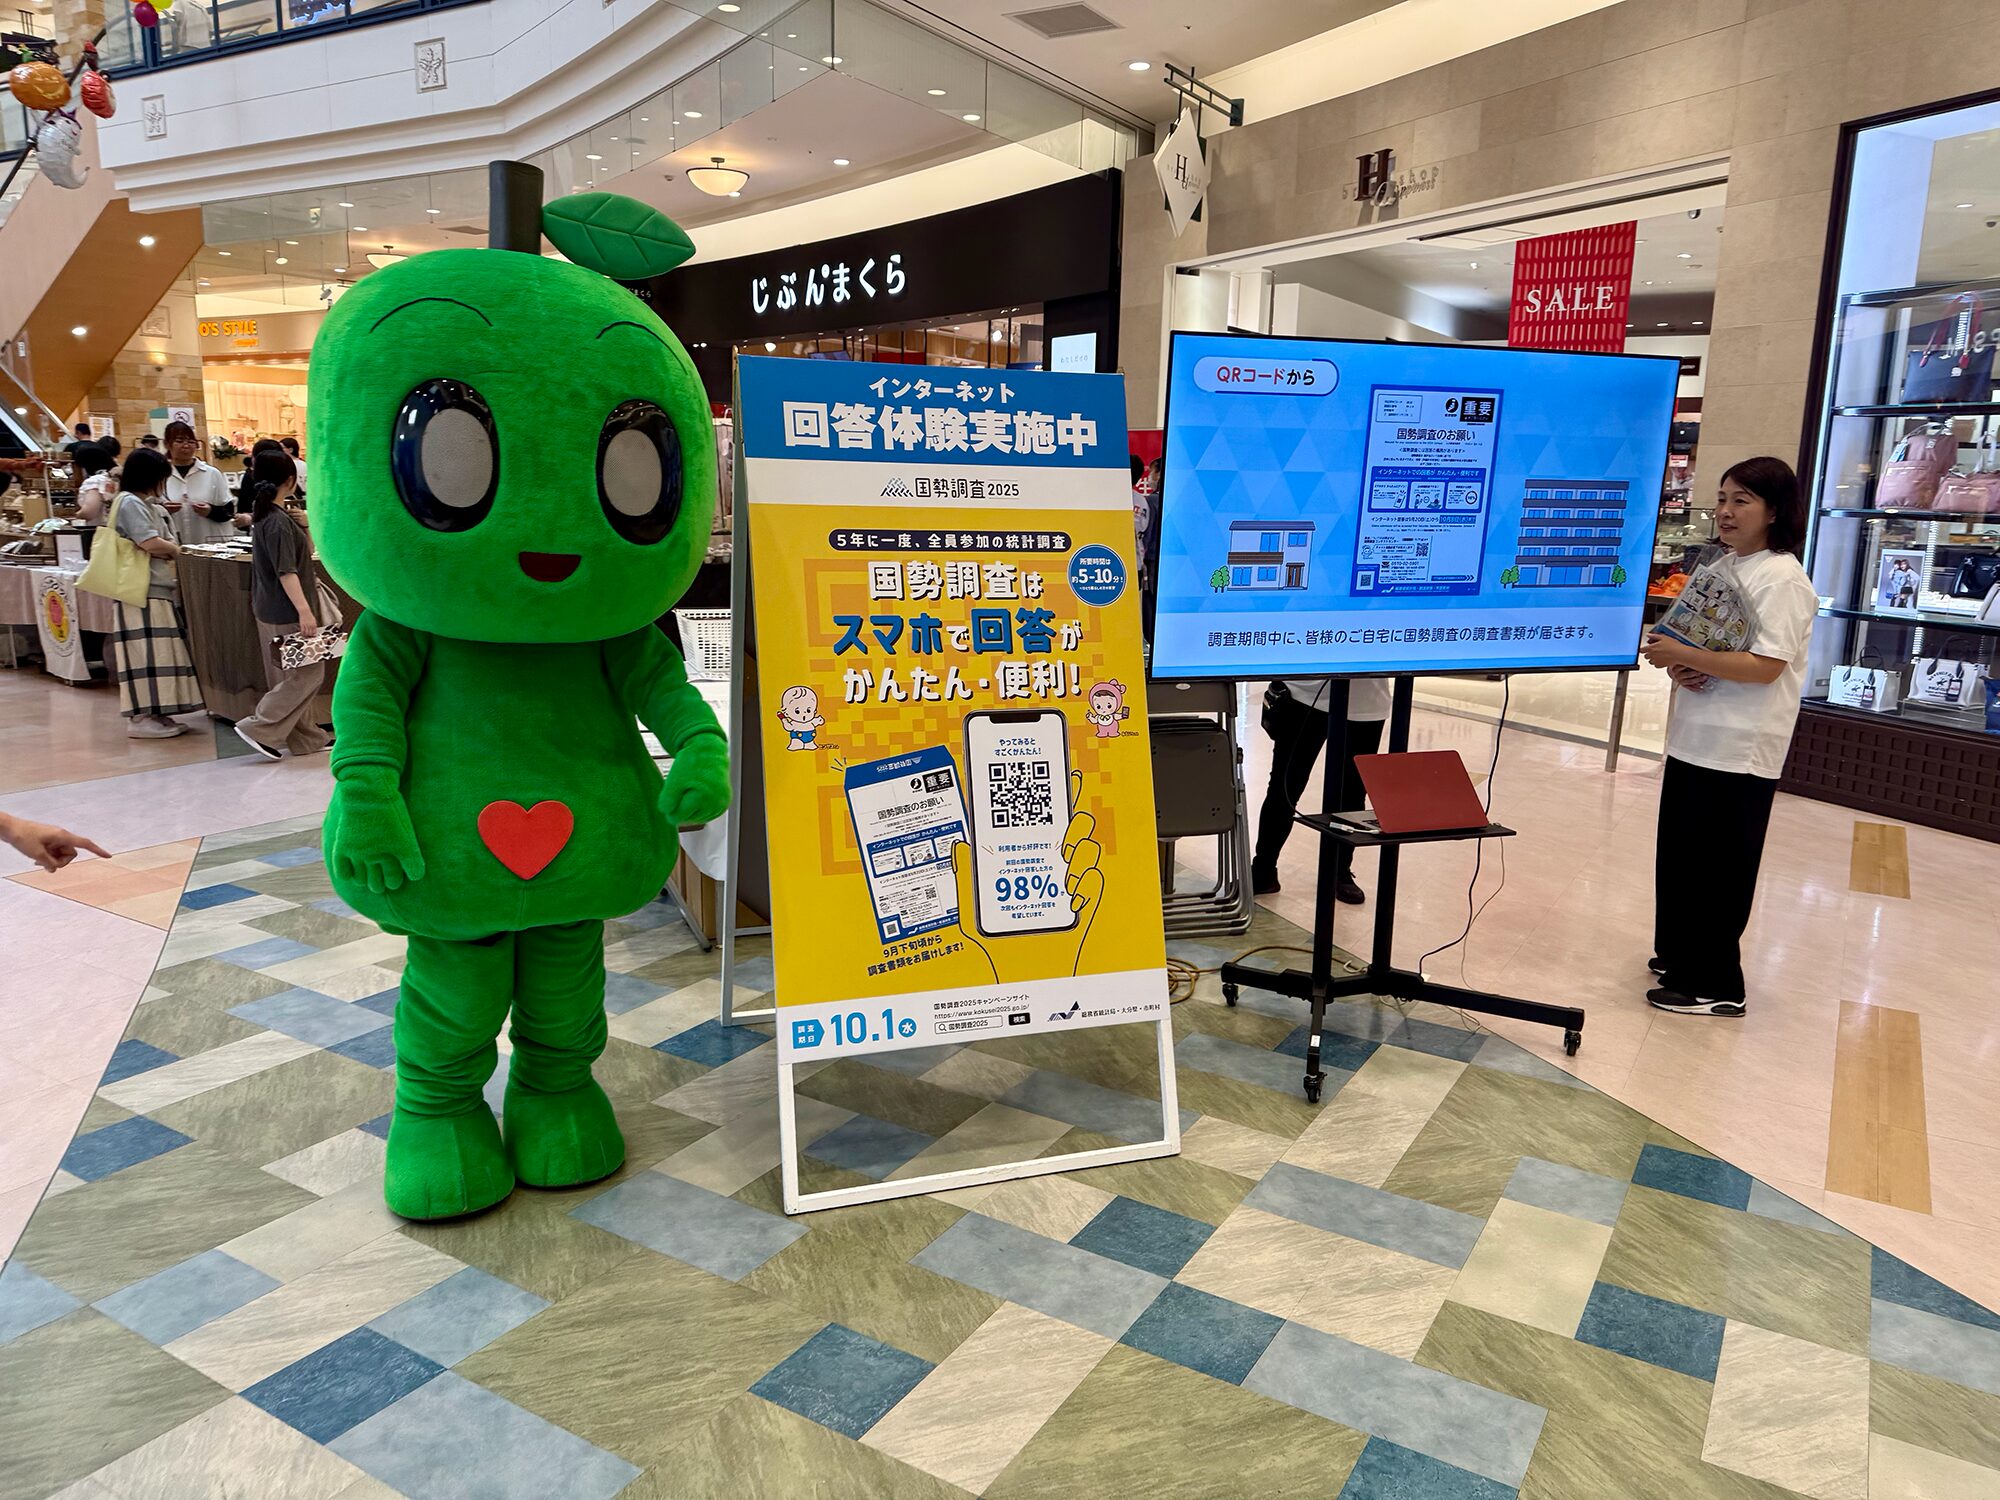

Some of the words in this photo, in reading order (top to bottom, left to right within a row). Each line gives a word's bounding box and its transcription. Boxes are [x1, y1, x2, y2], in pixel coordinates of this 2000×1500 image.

[1525, 286, 1614, 313] SALE
[222, 319, 257, 336] STYLE
[1216, 366, 1316, 386] QRコードから
[869, 377, 1015, 404] インターネット
[1464, 401, 1492, 416] 重要
[782, 400, 1098, 456] 回答体験実施中
[1396, 428, 1476, 441] 国勢調査のお願い
[914, 477, 1020, 500] 国勢調査2025
[836, 532, 1067, 551] 5年に一度、全員参加の統計調査
[868, 560, 1043, 602] 国勢調査は
[832, 606, 1083, 657] スマホで回答が
[1207, 625, 1595, 648] 調査期間中に、皆様のご自宅に国勢調査の調査書類が届きます。
[842, 659, 1081, 704] かんたん・便利!
[999, 738, 1036, 747] やってみると
[925, 772, 952, 788] 重要
[995, 874, 1059, 902] 98%
[883, 934, 943, 958] 9月下旬頃から
[867, 942, 964, 976] 調査書類をお届けします!
[933, 994, 1030, 1010] 国勢調査2025キャンペーンサイト
[830, 1008, 894, 1046] 10.1
[901, 1021, 914, 1036] 水
[948, 1020, 989, 1031] 国勢調査2025
